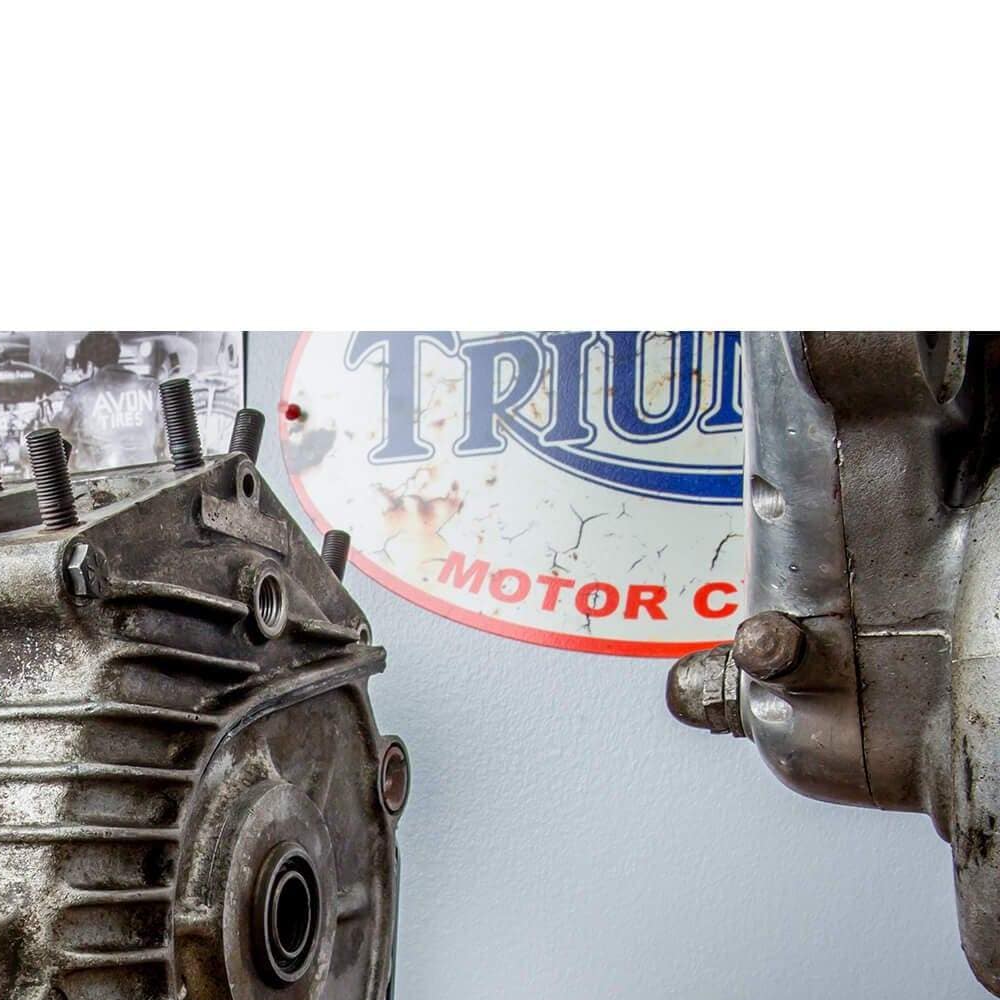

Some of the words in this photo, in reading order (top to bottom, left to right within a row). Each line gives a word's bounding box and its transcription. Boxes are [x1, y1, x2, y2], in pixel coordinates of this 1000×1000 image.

[92, 389, 153, 417] AVON
[345, 331, 743, 465] TRIU
[438, 551, 668, 621] MOTOR
